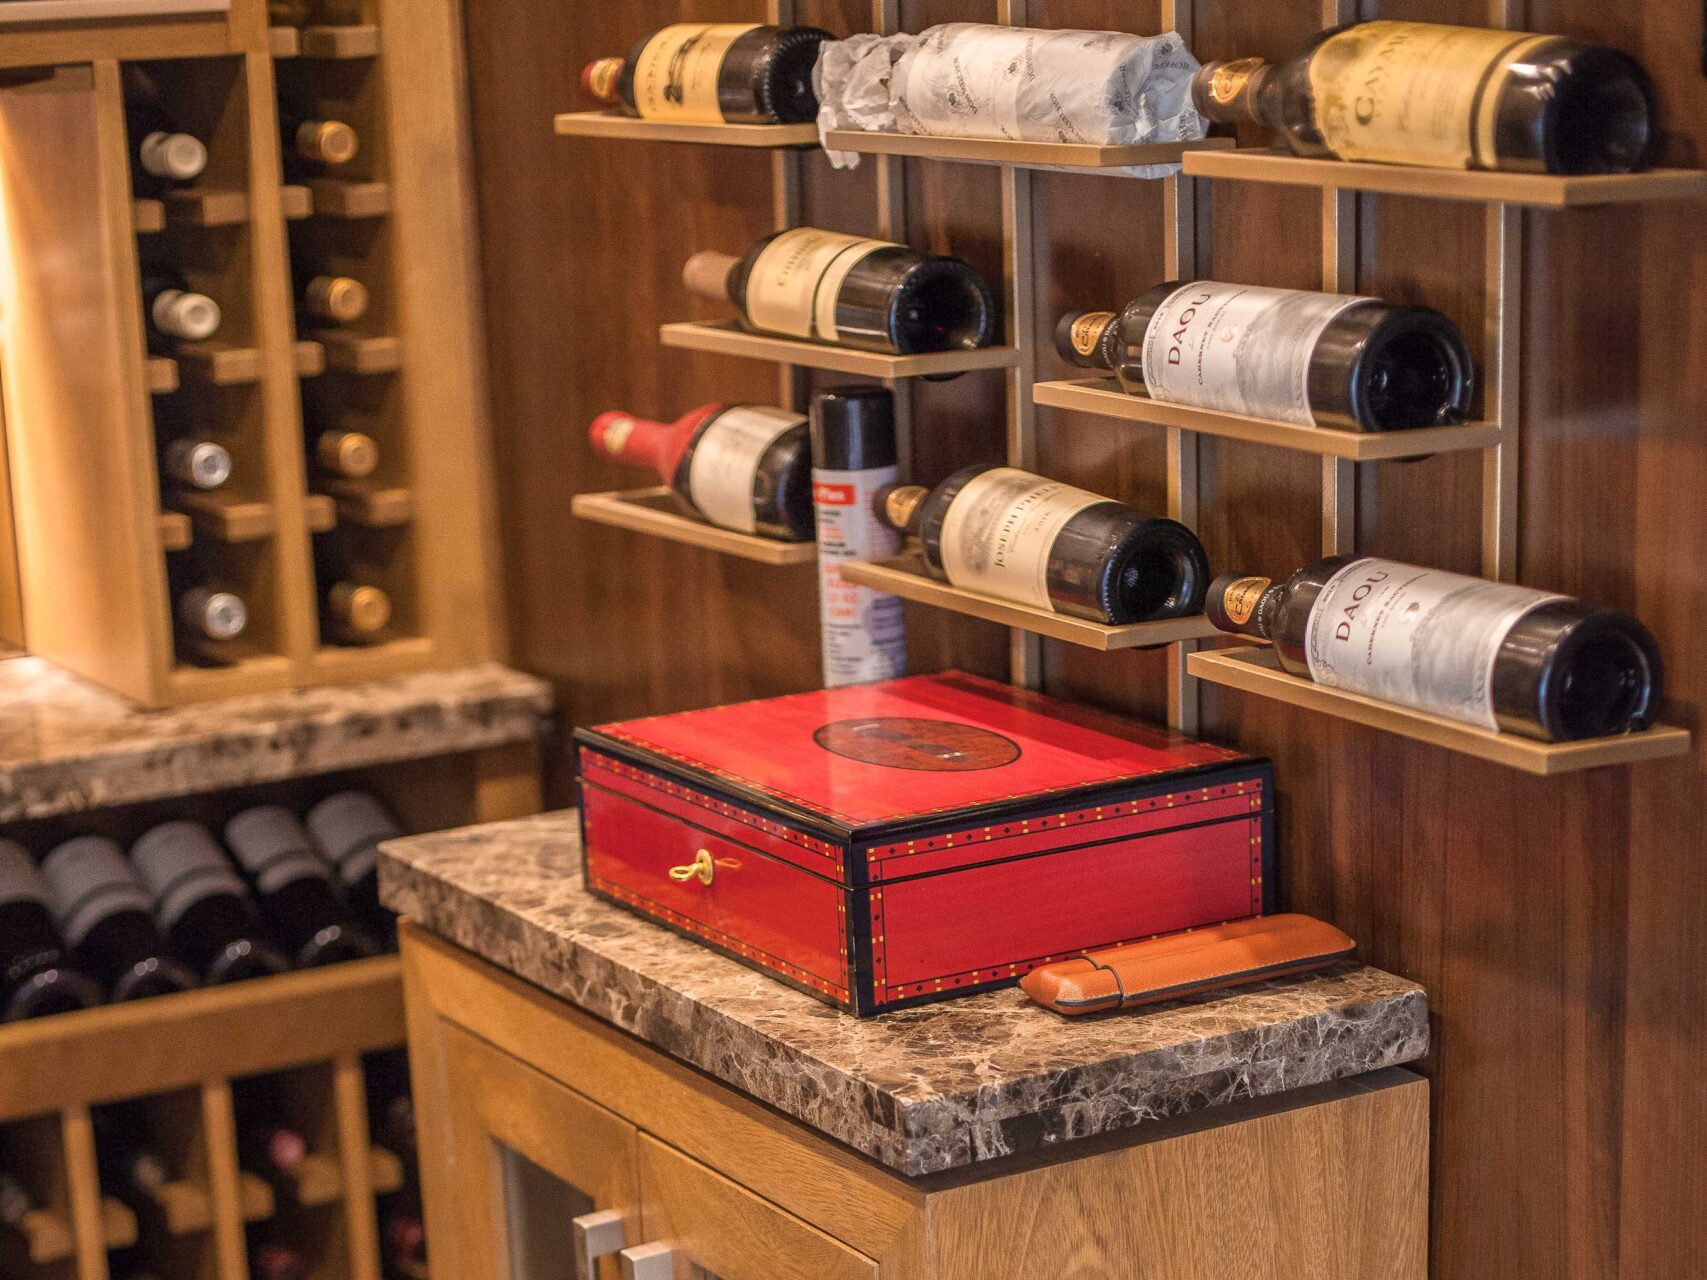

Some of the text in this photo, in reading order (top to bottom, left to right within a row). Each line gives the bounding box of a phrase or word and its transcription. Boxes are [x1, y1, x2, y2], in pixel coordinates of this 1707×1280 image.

[1168, 292, 1211, 366] DAOU
[1196, 330, 1210, 385] CABERNET
[995, 509, 1019, 568] JOSEPH
[1258, 593, 1270, 615] DAOU
[1336, 571, 1389, 642] DAOU
[1367, 609, 1385, 665] CABERNET
